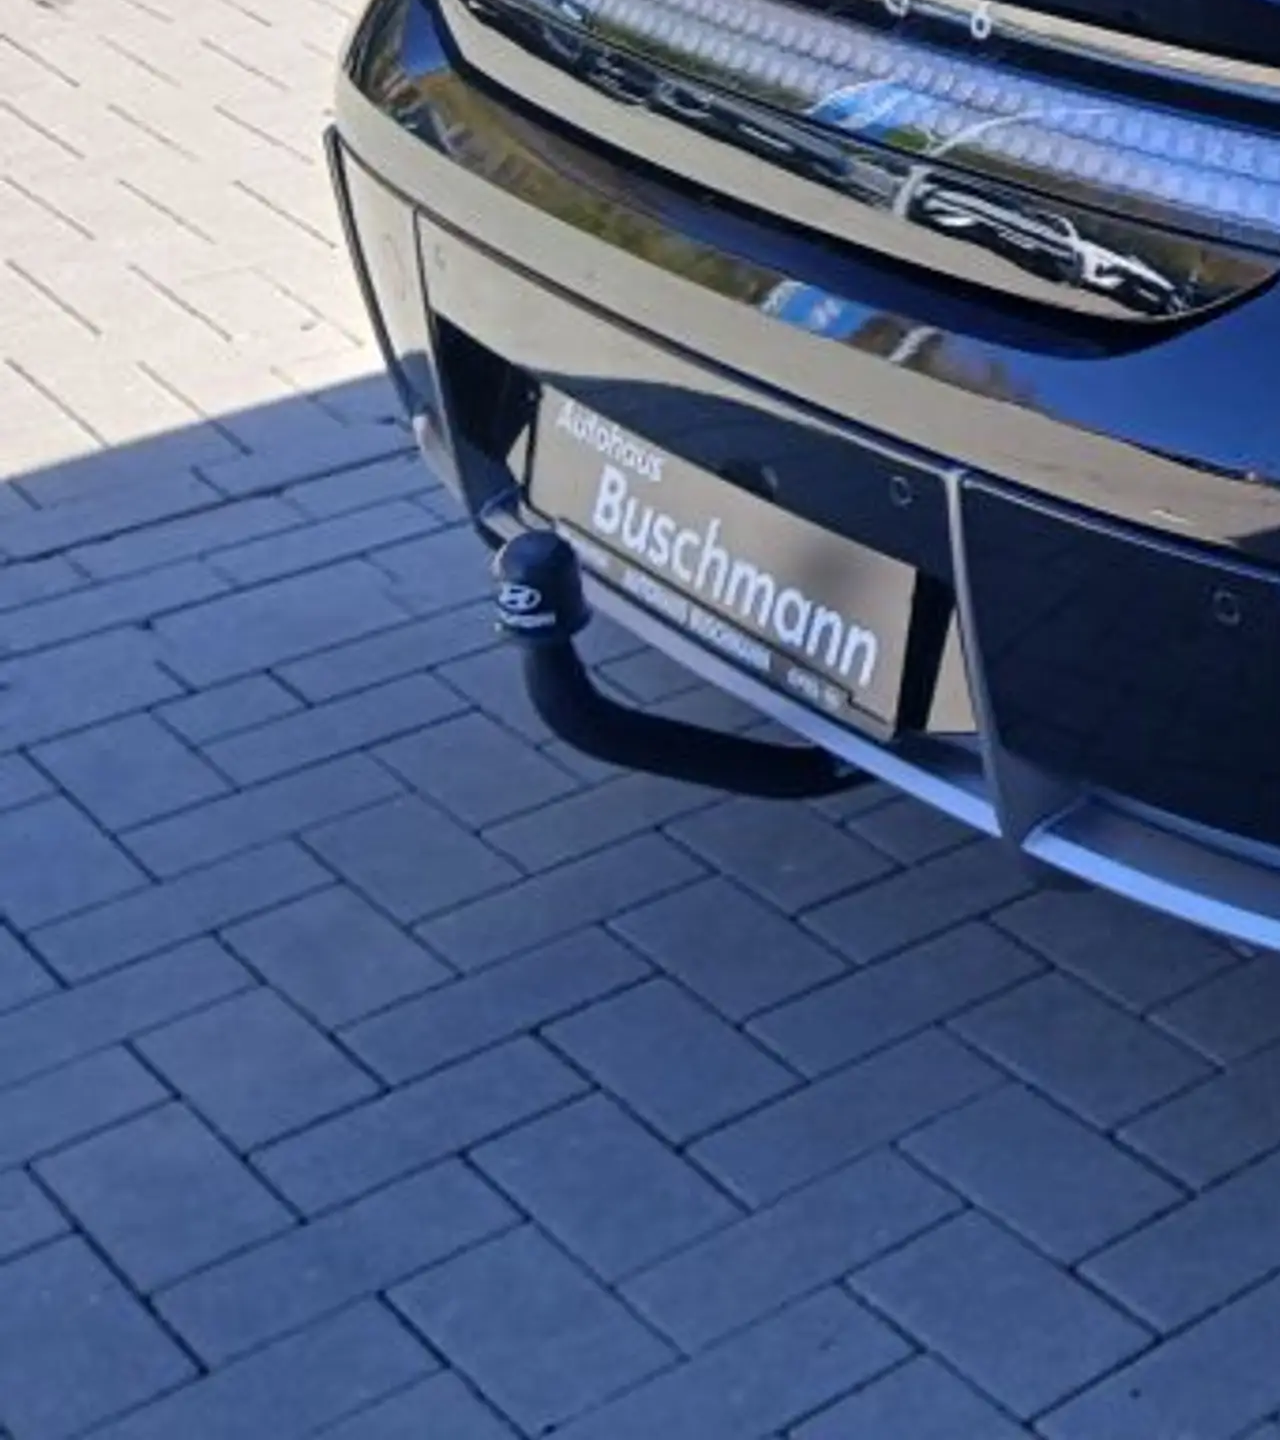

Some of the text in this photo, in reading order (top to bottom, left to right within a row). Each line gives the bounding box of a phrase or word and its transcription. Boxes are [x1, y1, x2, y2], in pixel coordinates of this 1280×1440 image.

[970, 0, 992, 40] 6
[556, 399, 666, 483] Autohaus
[592, 464, 878, 687] Buschmann
